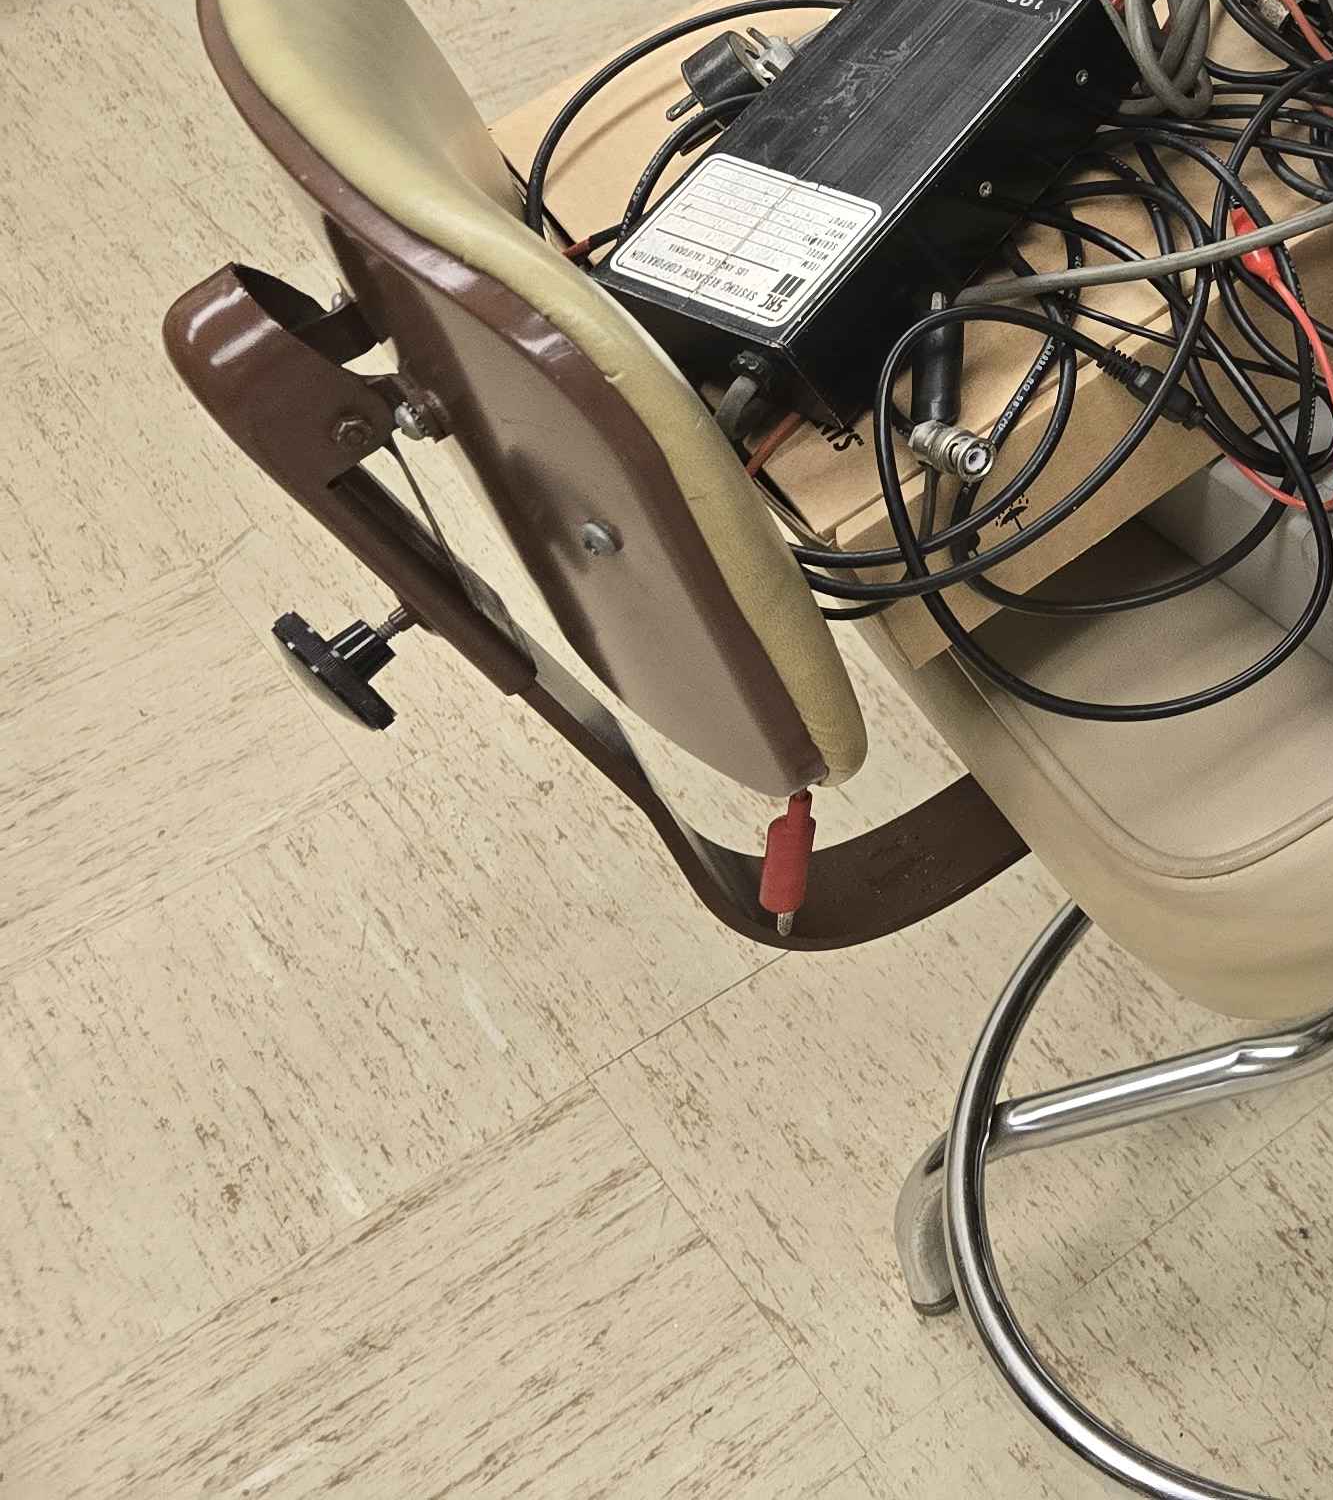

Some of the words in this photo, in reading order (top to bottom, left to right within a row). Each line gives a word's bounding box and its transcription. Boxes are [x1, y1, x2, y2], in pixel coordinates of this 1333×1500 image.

[629, 249, 683, 275] CORPORATION
[667, 242, 707, 263] CALIFORNIA
[679, 269, 720, 291] RESEARCH
[736, 266, 750, 277] LOS
[720, 280, 759, 303] SYSTEMS
[757, 292, 789, 313] SRC
